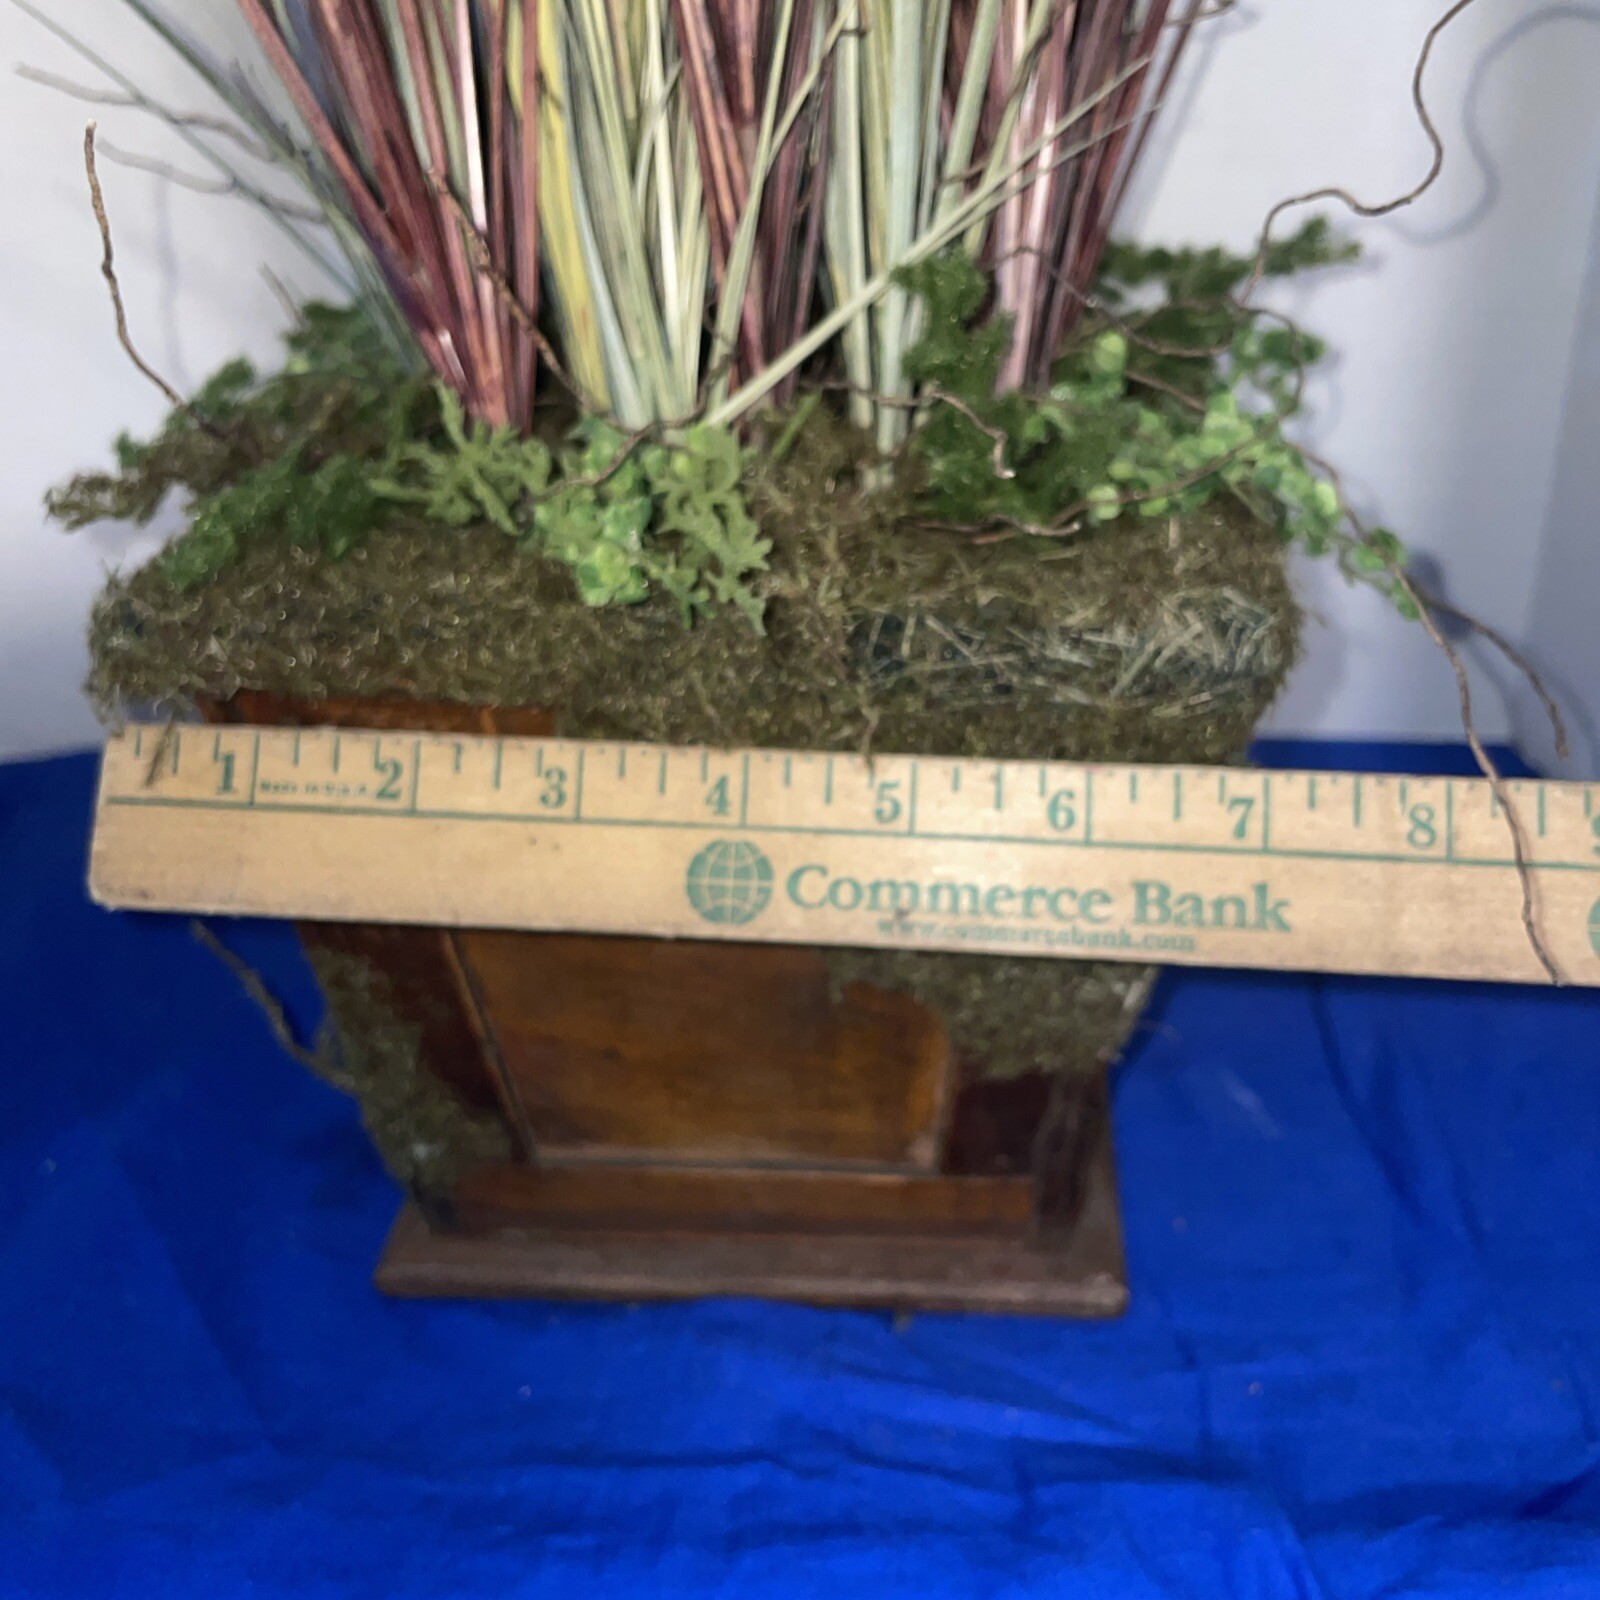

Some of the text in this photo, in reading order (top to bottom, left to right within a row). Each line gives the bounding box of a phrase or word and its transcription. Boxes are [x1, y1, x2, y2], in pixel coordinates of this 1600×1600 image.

[215, 752, 237, 793] 1
[374, 758, 404, 800] 2
[540, 768, 567, 810] 3
[704, 776, 731, 817] 4
[874, 780, 902, 823] 5
[1048, 788, 1077, 832] 6
[1227, 797, 1255, 840] 7
[1407, 803, 1437, 849] 8
[786, 864, 1292, 932] Commerce Bank
